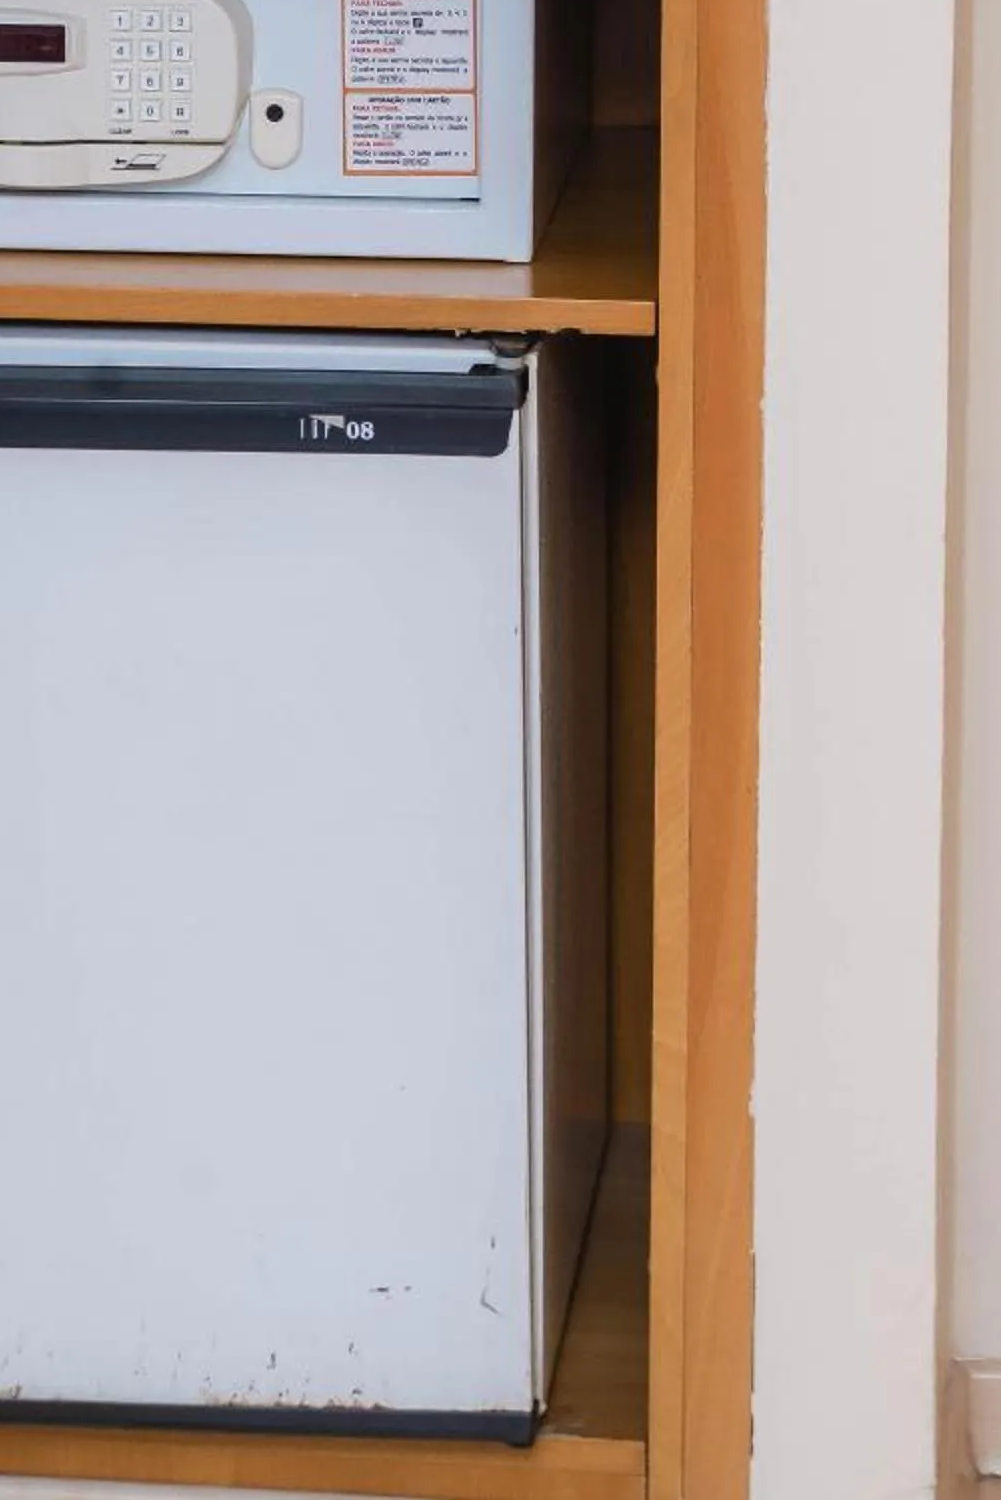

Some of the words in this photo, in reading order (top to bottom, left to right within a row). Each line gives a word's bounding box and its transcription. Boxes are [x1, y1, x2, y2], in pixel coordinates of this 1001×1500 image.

[148, 16, 154, 26] 2
[176, 17, 184, 27] 3
[116, 46, 124, 56] 4
[146, 46, 154, 56] 5
[116, 75, 124, 85] 7
[146, 106, 154, 117] 0
[346, 421, 374, 440] 08
